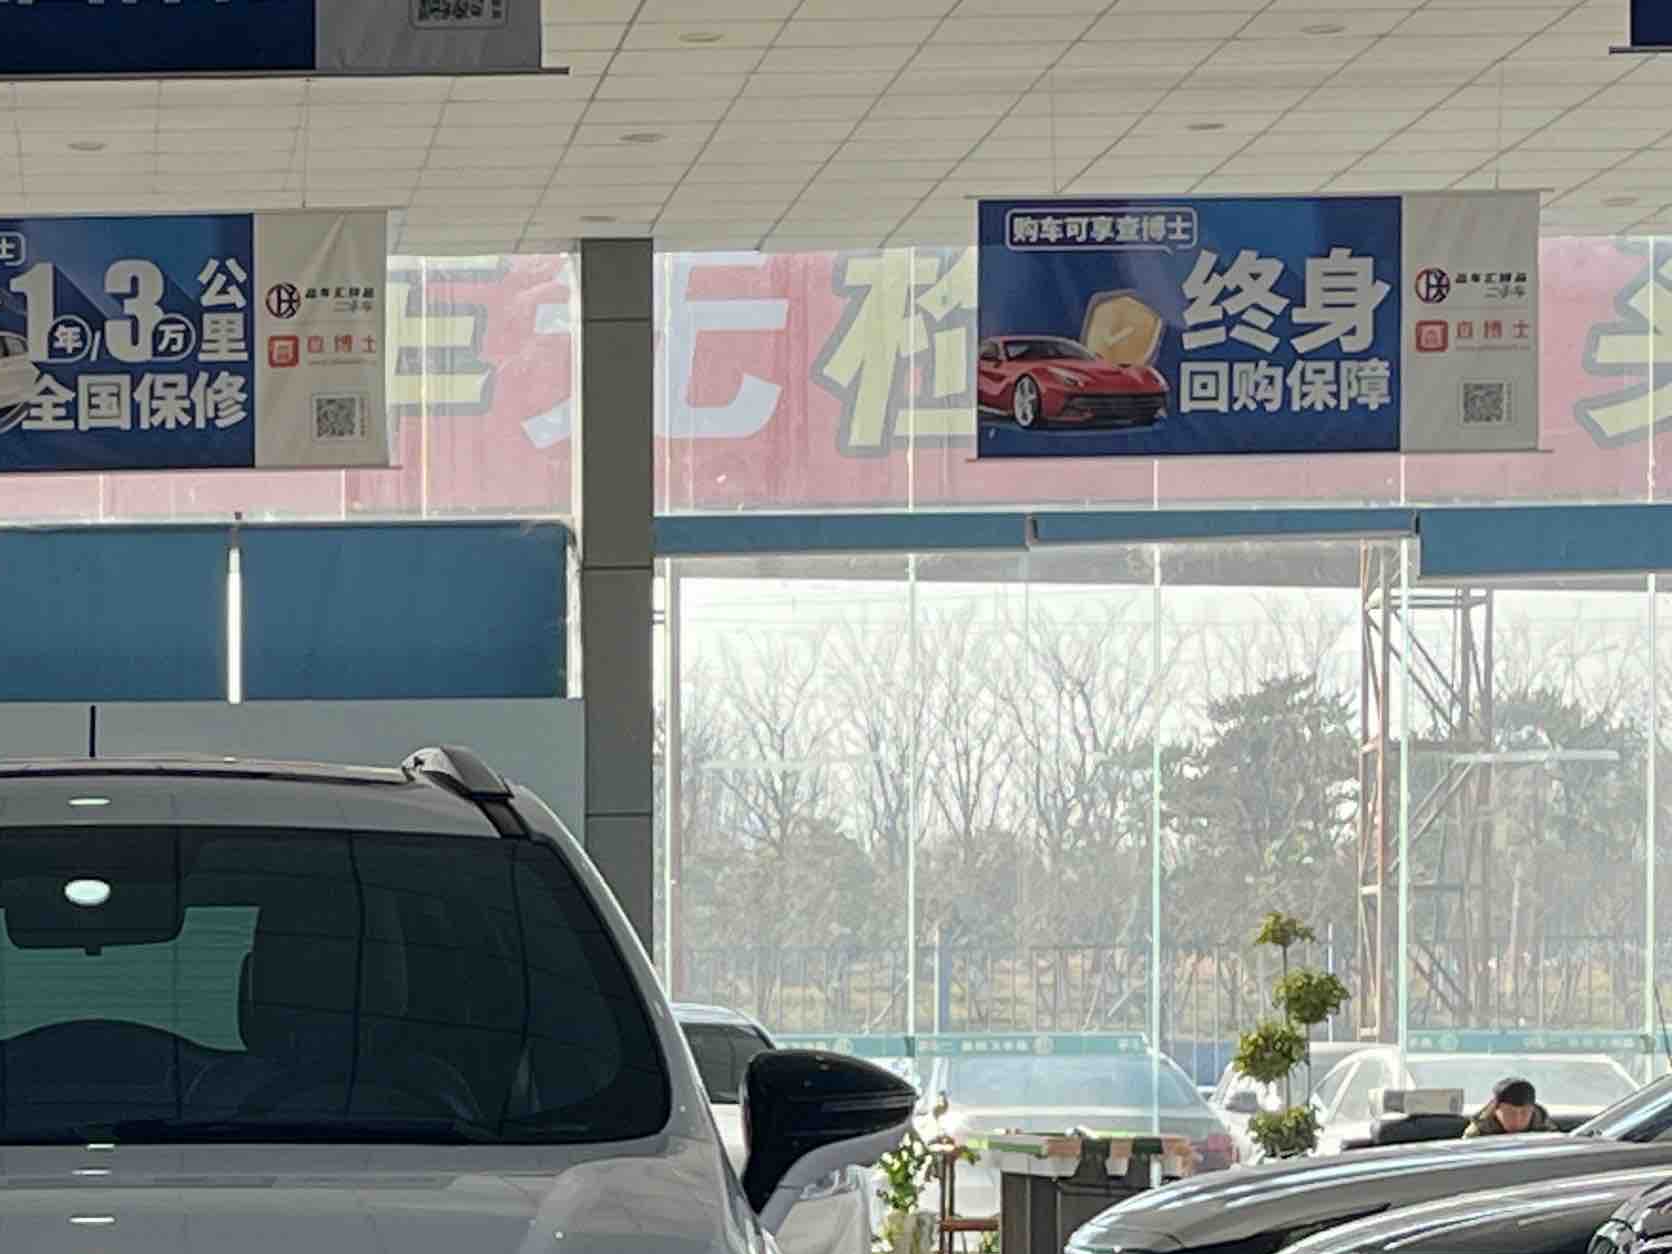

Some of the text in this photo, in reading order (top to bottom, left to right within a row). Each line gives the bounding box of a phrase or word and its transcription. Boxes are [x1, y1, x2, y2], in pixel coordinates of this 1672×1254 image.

[1012, 213, 1192, 245] 购车可享查博士
[1180, 247, 1390, 356] 终身
[22, 370, 249, 432] 全国保修
[1178, 359, 1391, 414] 回购保障
